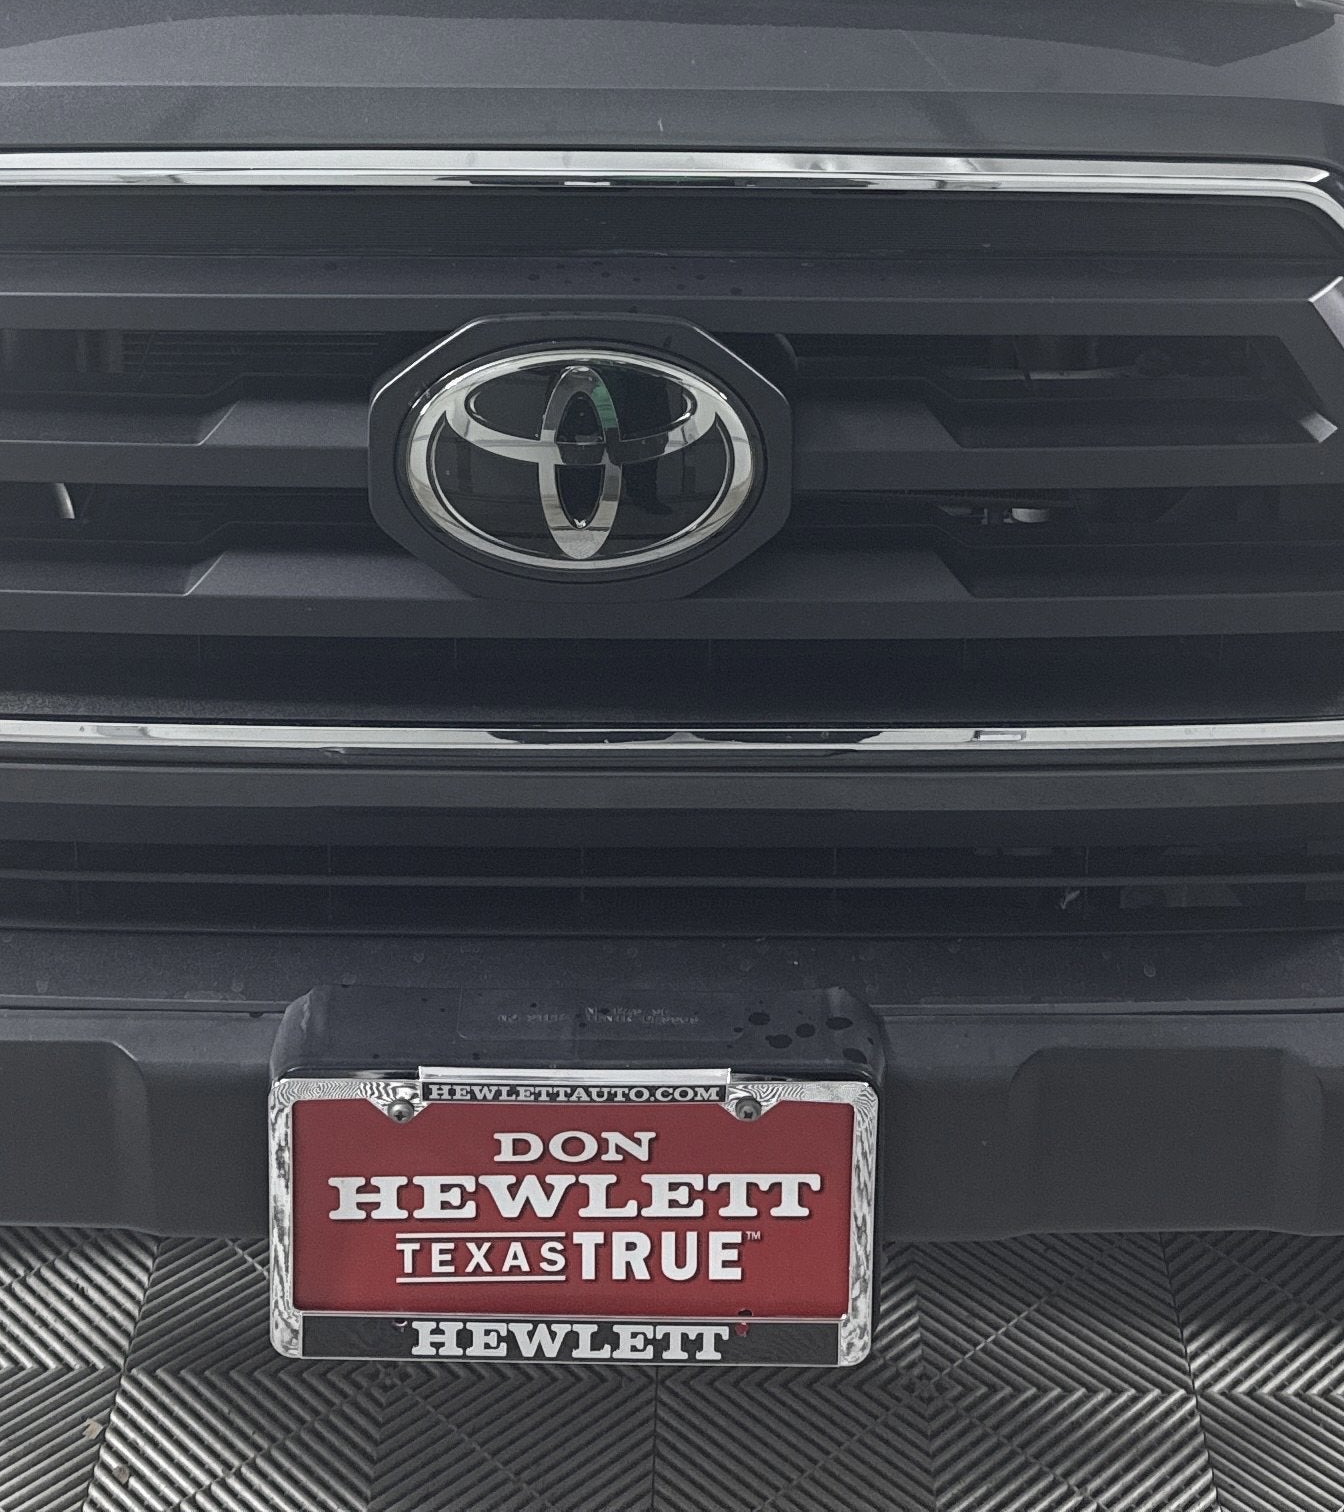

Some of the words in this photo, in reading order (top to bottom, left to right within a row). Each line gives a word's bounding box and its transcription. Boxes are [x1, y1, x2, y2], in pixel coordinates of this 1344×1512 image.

[428, 1084, 720, 1102] HEWLETTAUTO.COM
[493, 1131, 657, 1164] DON
[327, 1174, 822, 1221] HEWLETT
[396, 1242, 567, 1275] TEXAS
[411, 1321, 729, 1361] HEWLETT
